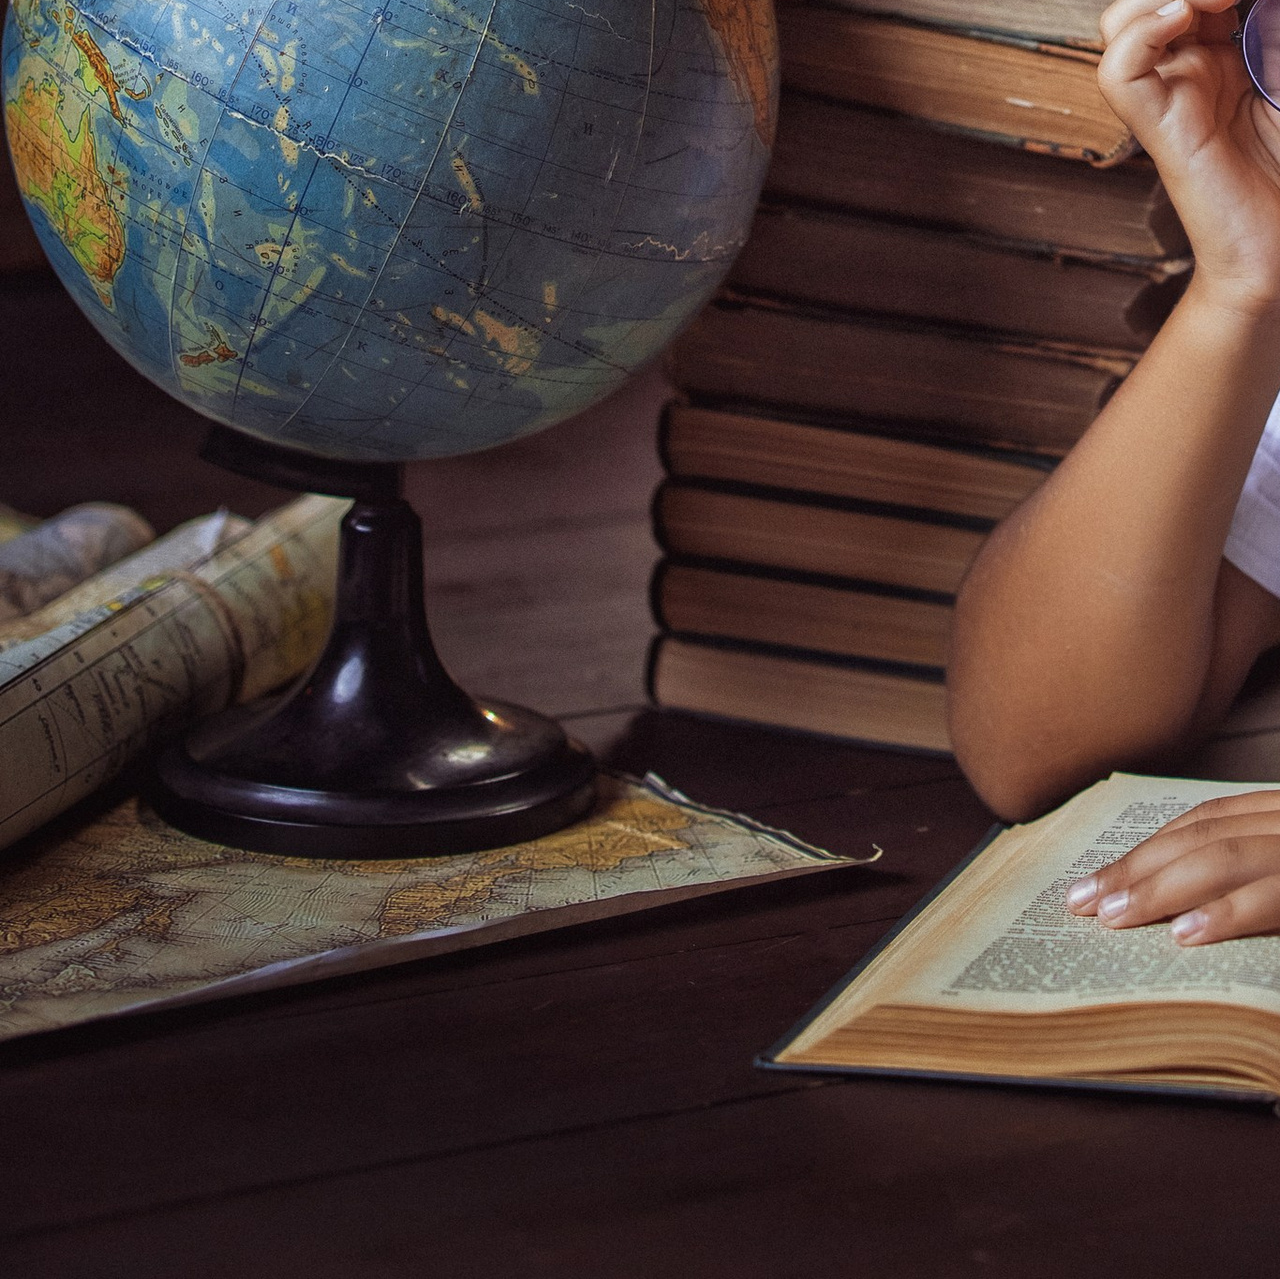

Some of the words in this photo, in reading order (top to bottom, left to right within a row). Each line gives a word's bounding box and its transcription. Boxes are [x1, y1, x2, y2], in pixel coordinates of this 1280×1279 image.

[191, 70, 215, 87] 160°
[250, 104, 275, 121] 170°
[381, 162, 406, 179] 170°
